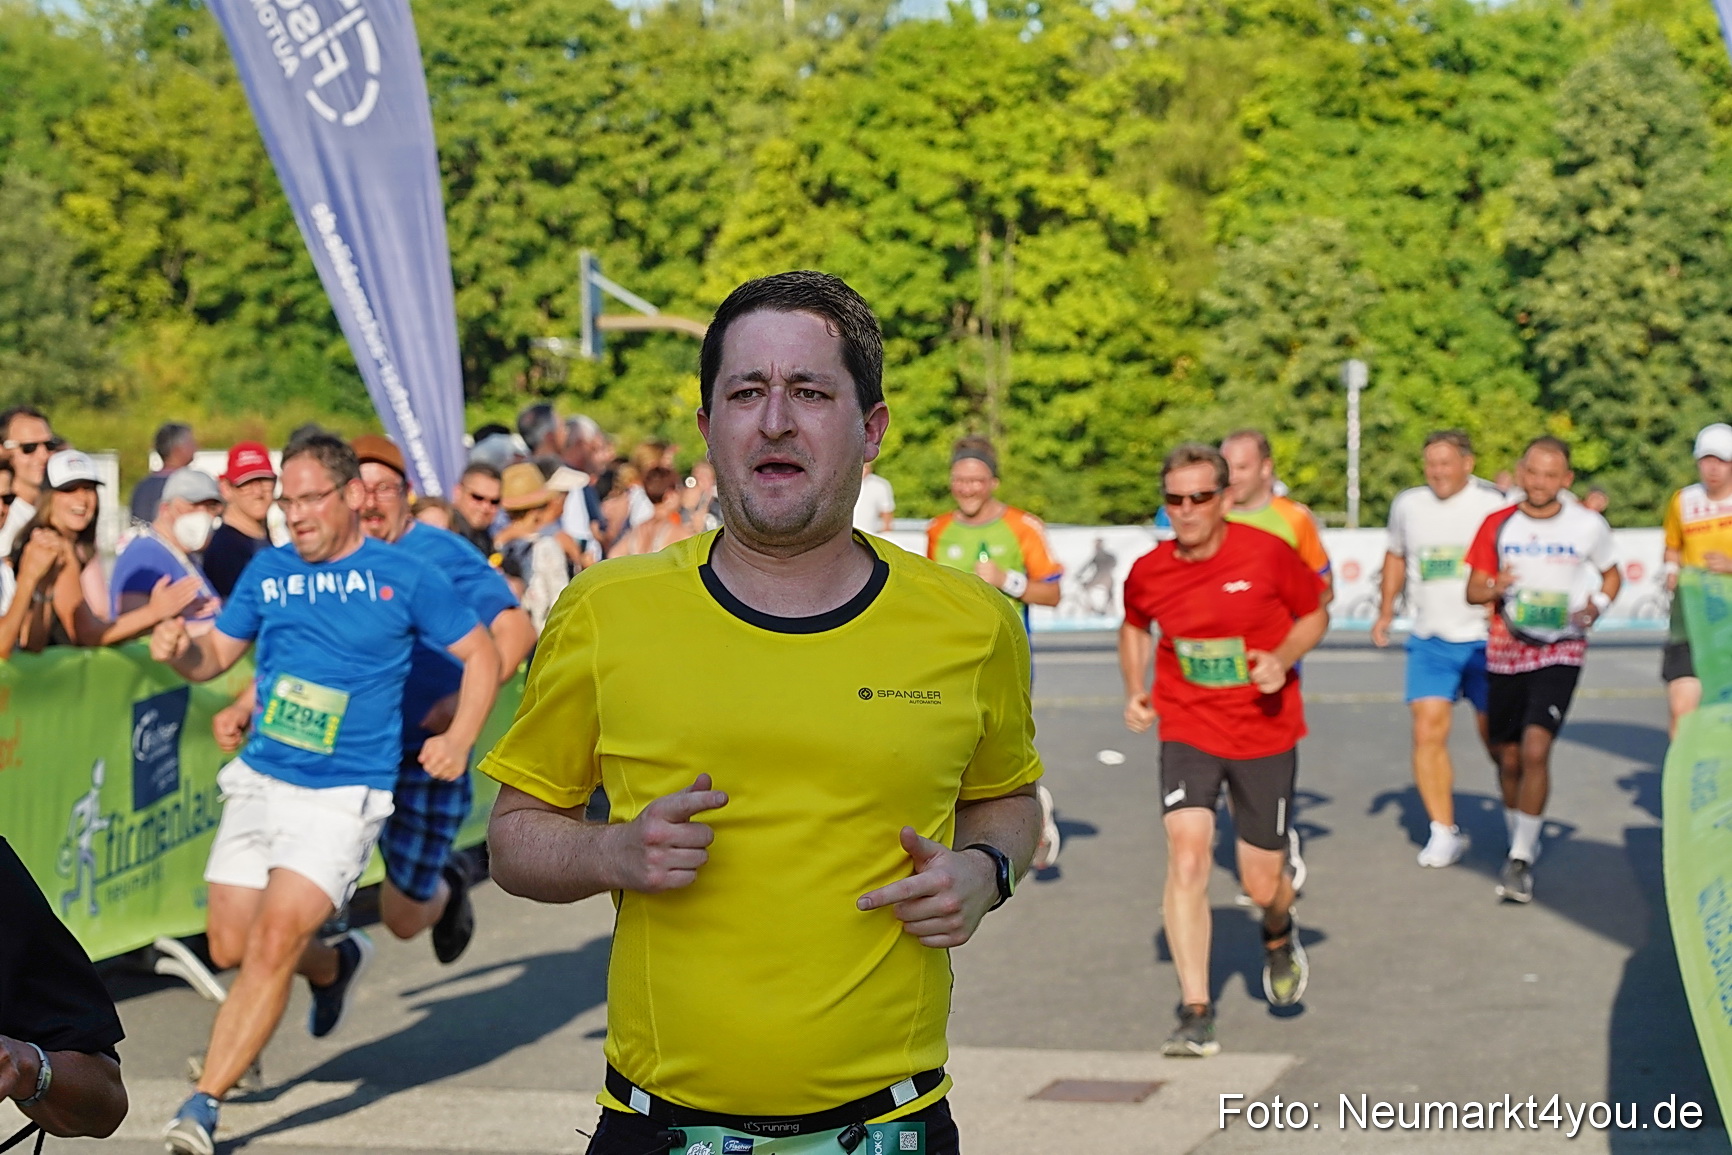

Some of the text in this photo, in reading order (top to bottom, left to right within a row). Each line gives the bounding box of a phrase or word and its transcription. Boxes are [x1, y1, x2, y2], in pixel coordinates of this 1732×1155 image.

[876, 689, 942, 700] SPANGLER
[279, 699, 328, 730] 1294
[762, 1123, 800, 1134] running
